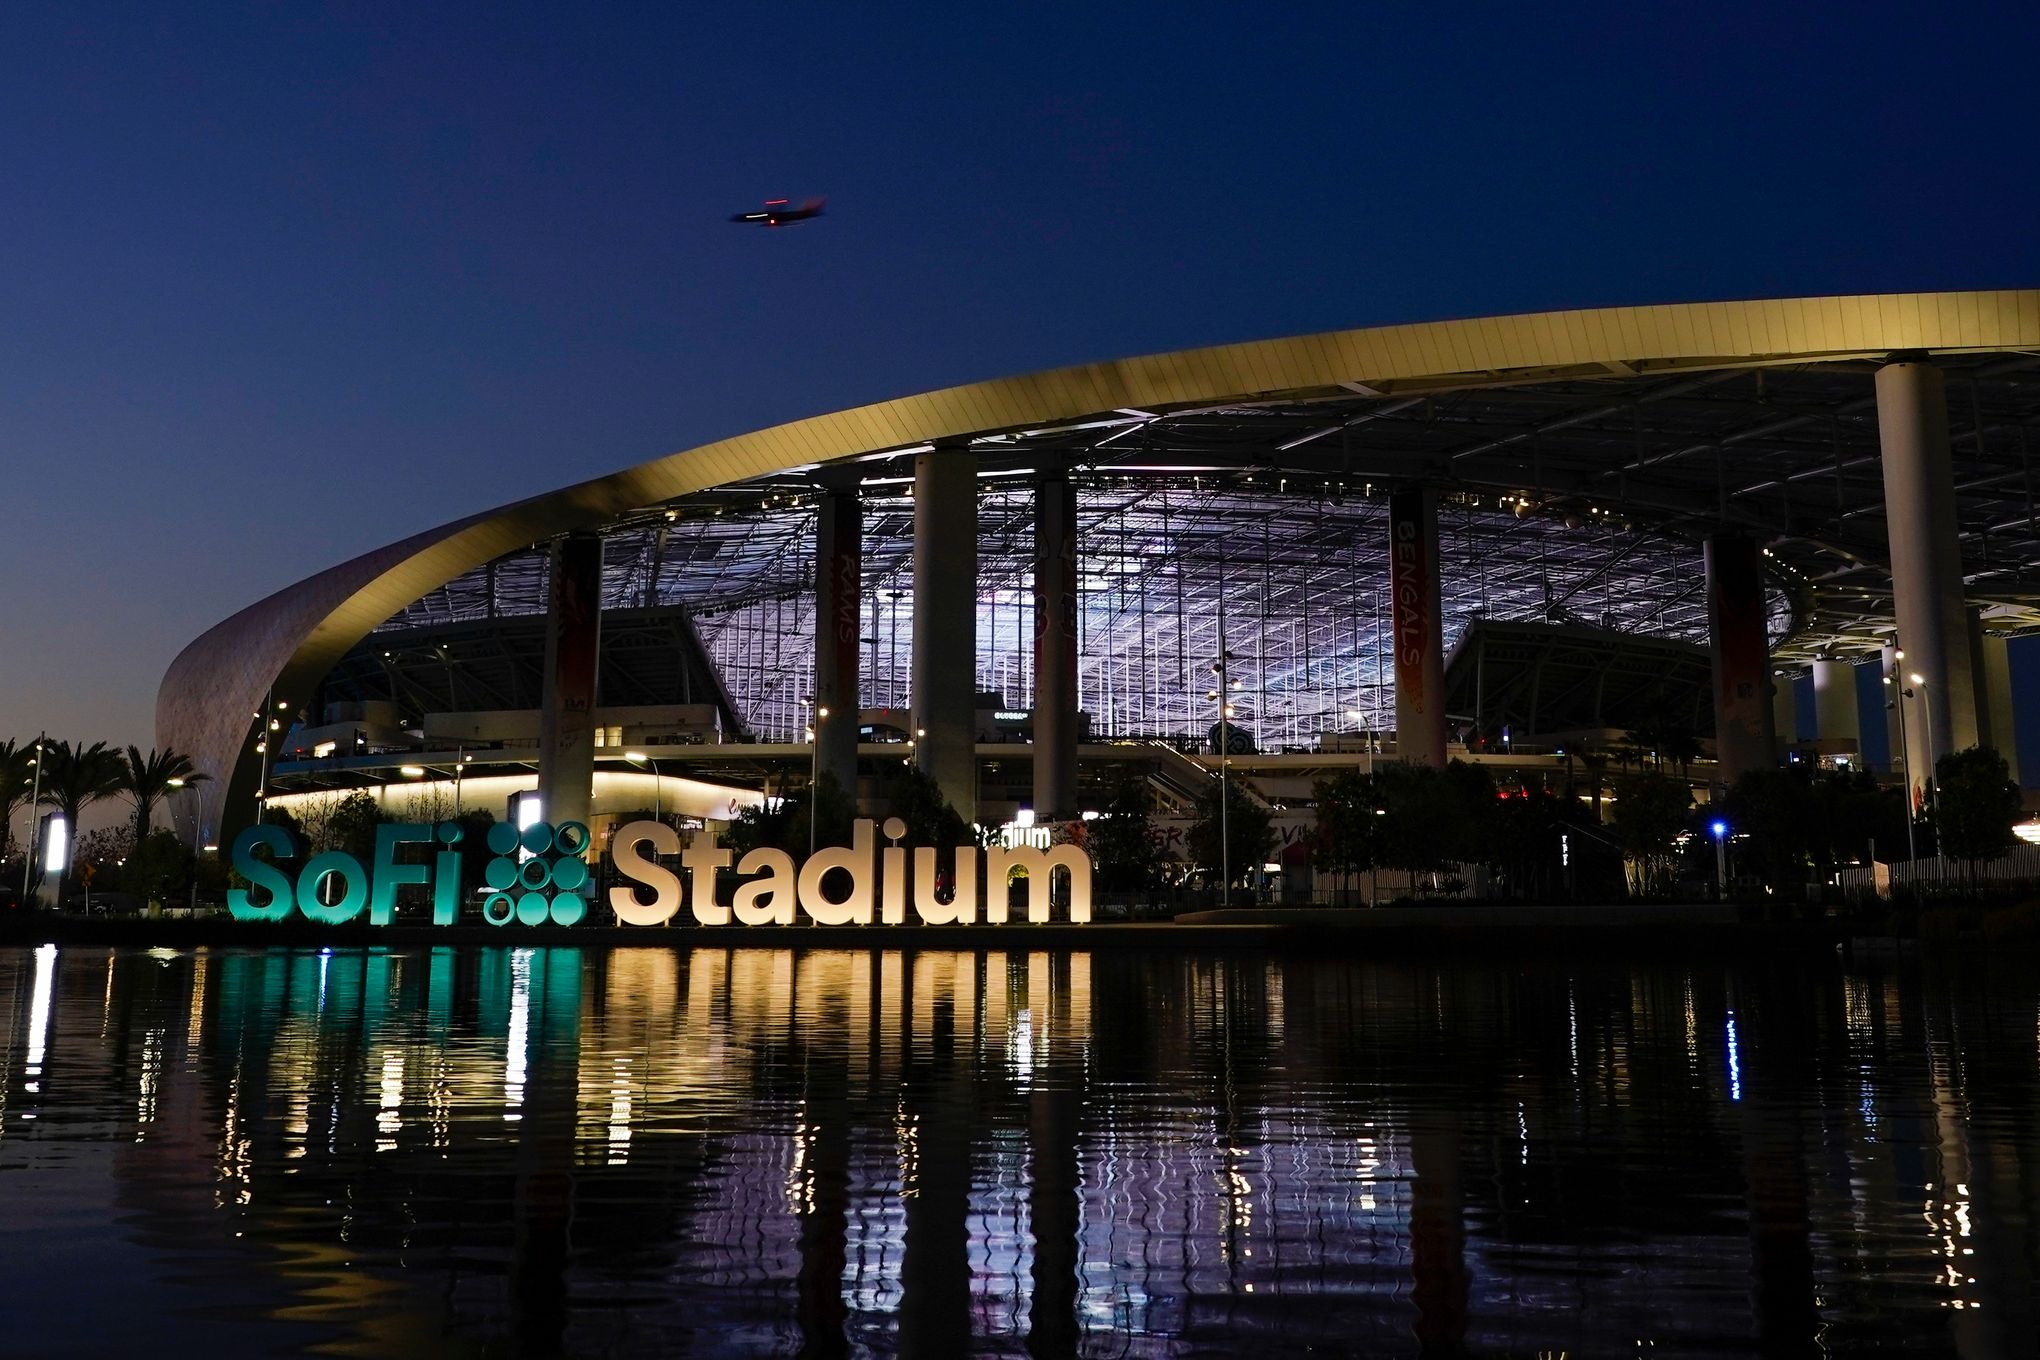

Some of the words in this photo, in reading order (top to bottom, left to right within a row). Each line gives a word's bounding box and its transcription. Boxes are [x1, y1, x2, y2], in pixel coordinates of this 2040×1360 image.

[839, 553, 855, 645] RAMS
[1397, 520, 1420, 667] BENGALS
[227, 821, 464, 927] SoFi
[609, 817, 1093, 926] Stadium
